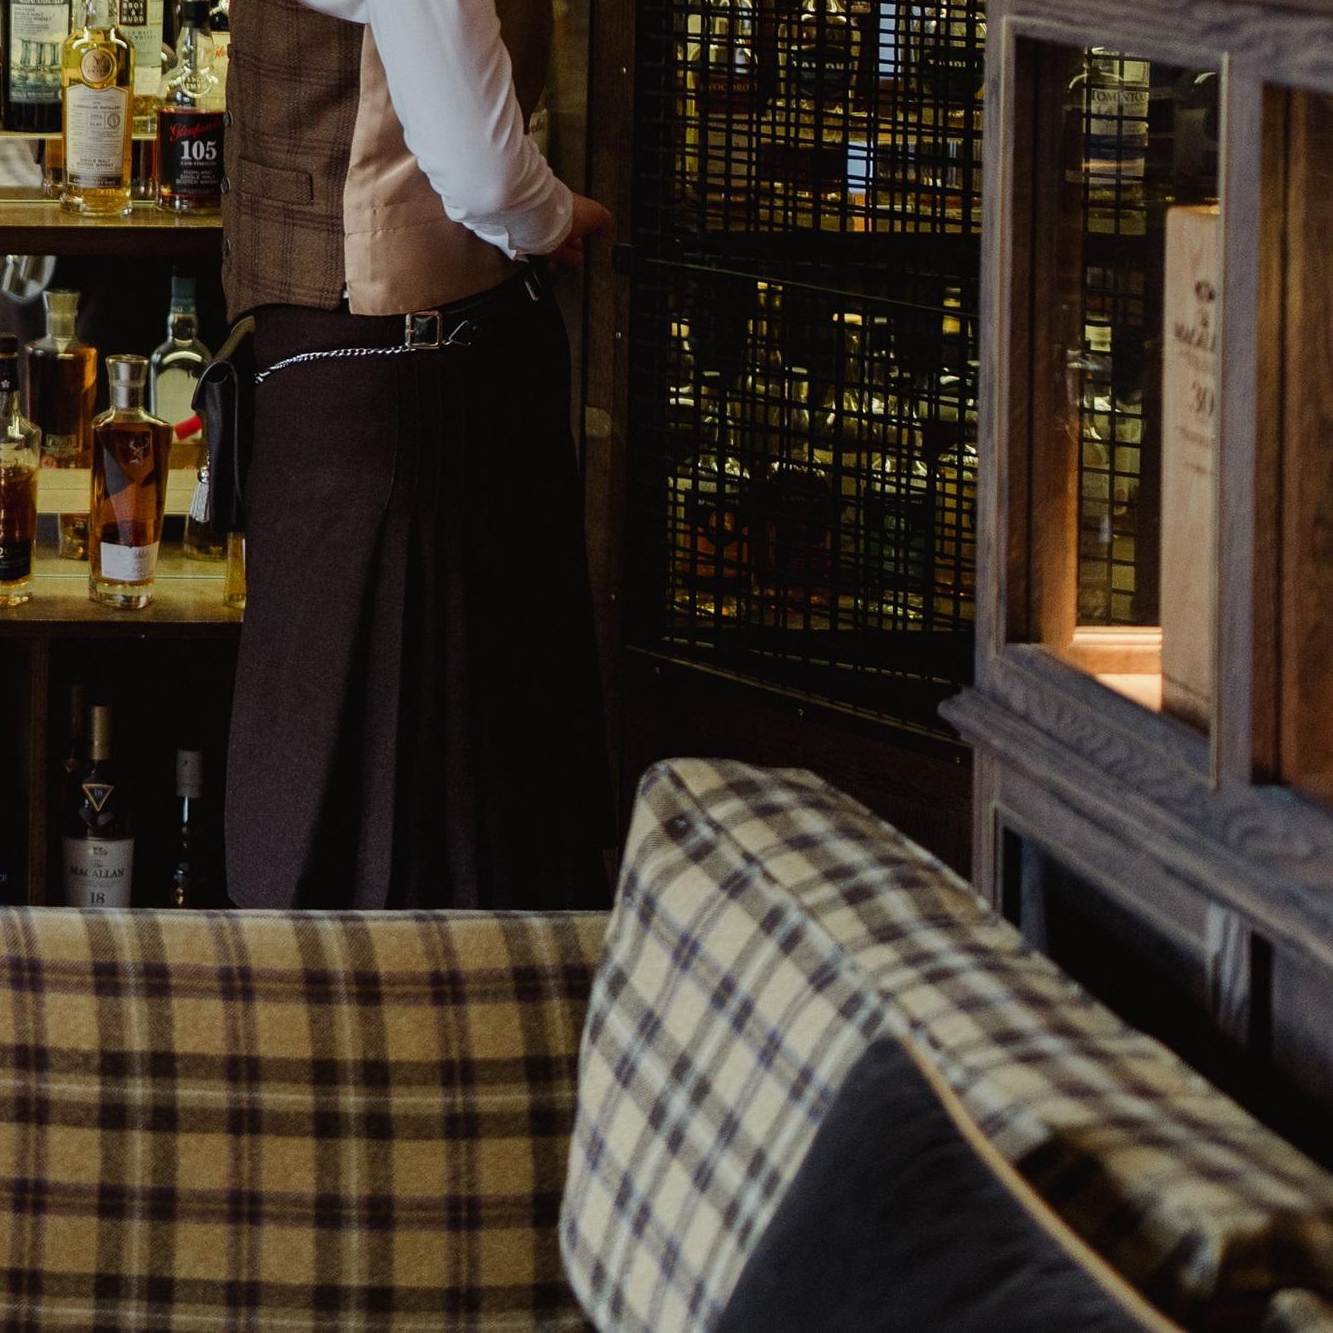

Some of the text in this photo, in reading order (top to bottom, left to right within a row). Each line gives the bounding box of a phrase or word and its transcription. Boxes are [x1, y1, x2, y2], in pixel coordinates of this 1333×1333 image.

[180, 139, 217, 161] 105
[70, 866, 126, 879] MACALLAN
[89, 892, 106, 905] 18
